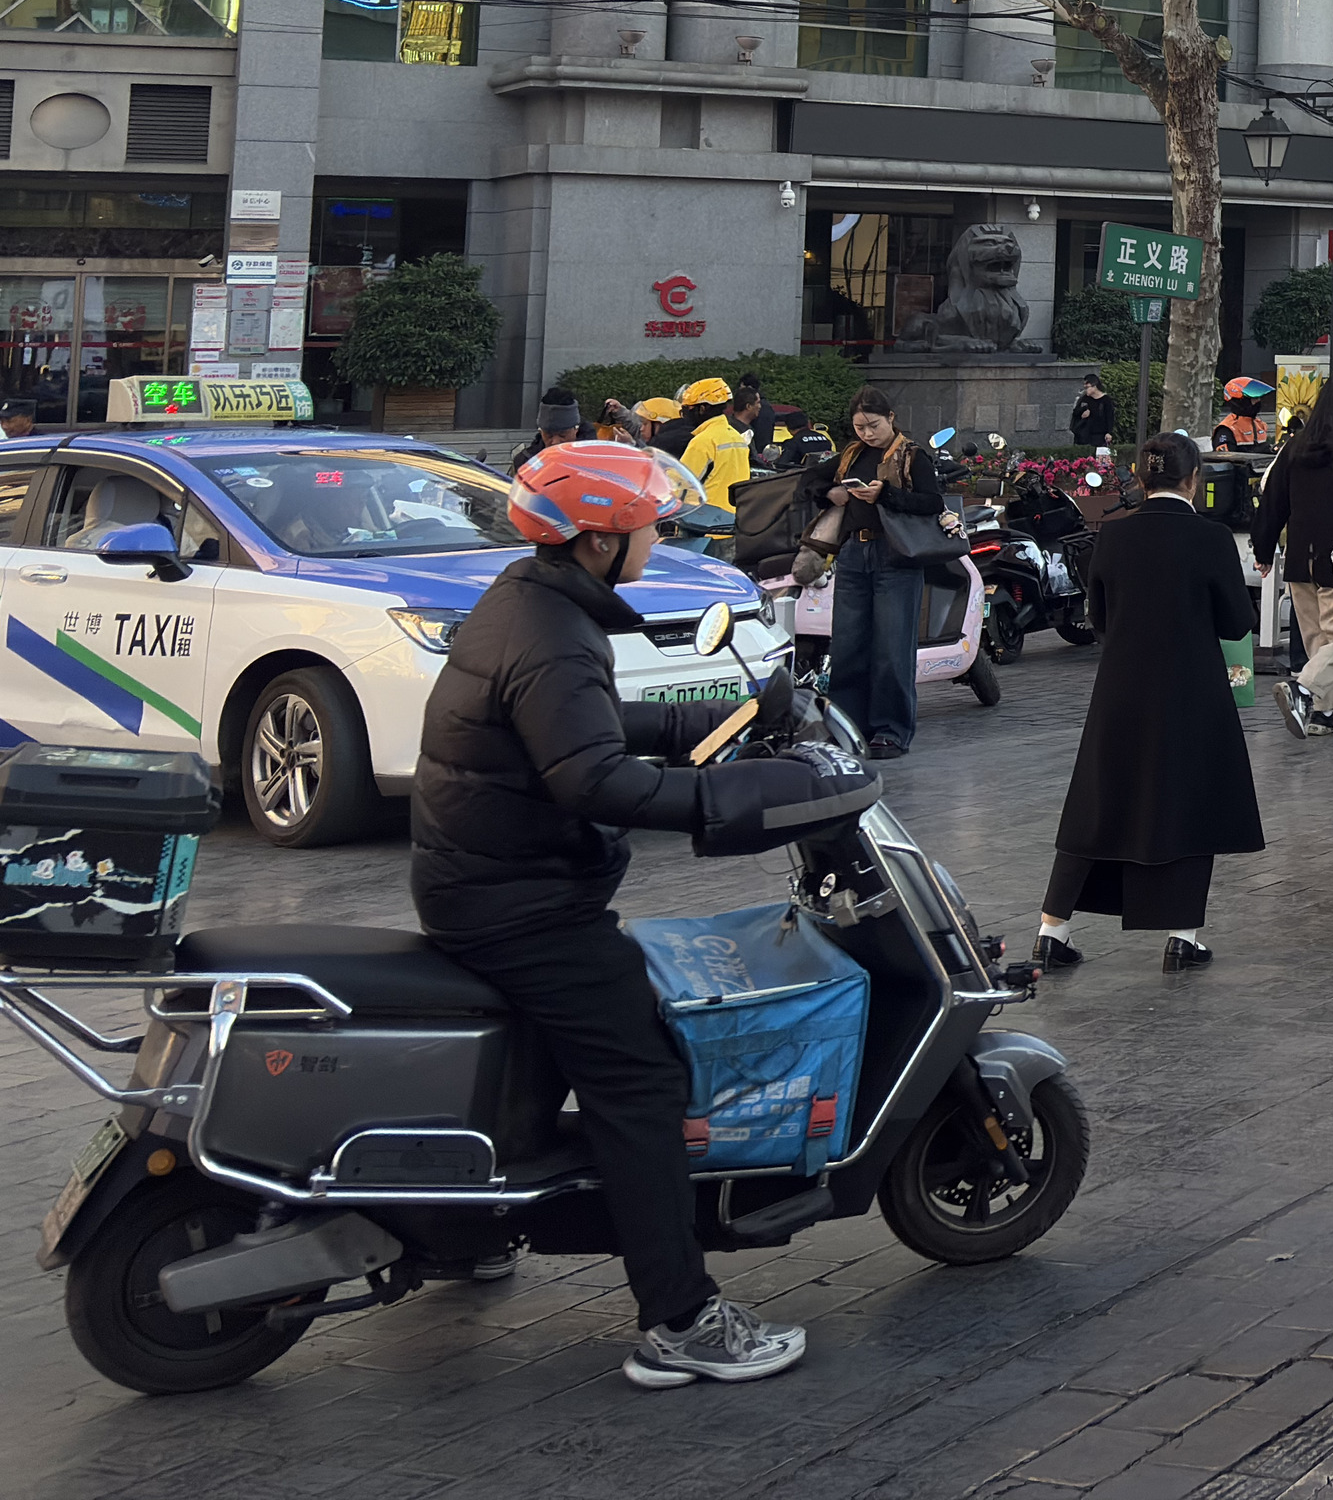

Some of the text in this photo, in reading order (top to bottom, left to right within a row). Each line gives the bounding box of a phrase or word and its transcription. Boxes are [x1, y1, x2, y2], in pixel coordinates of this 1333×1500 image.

[1117, 237, 1189, 275] 正义路
[1106, 270, 1195, 293] 北 ZHENGYI LU 南
[143, 381, 197, 406] 空车
[207, 383, 293, 412] 欢乐巧匠
[290, 383, 313, 418] 装饰
[315, 471, 344, 486] 空车
[63, 611, 195, 657] 世博 TAXI 出租
